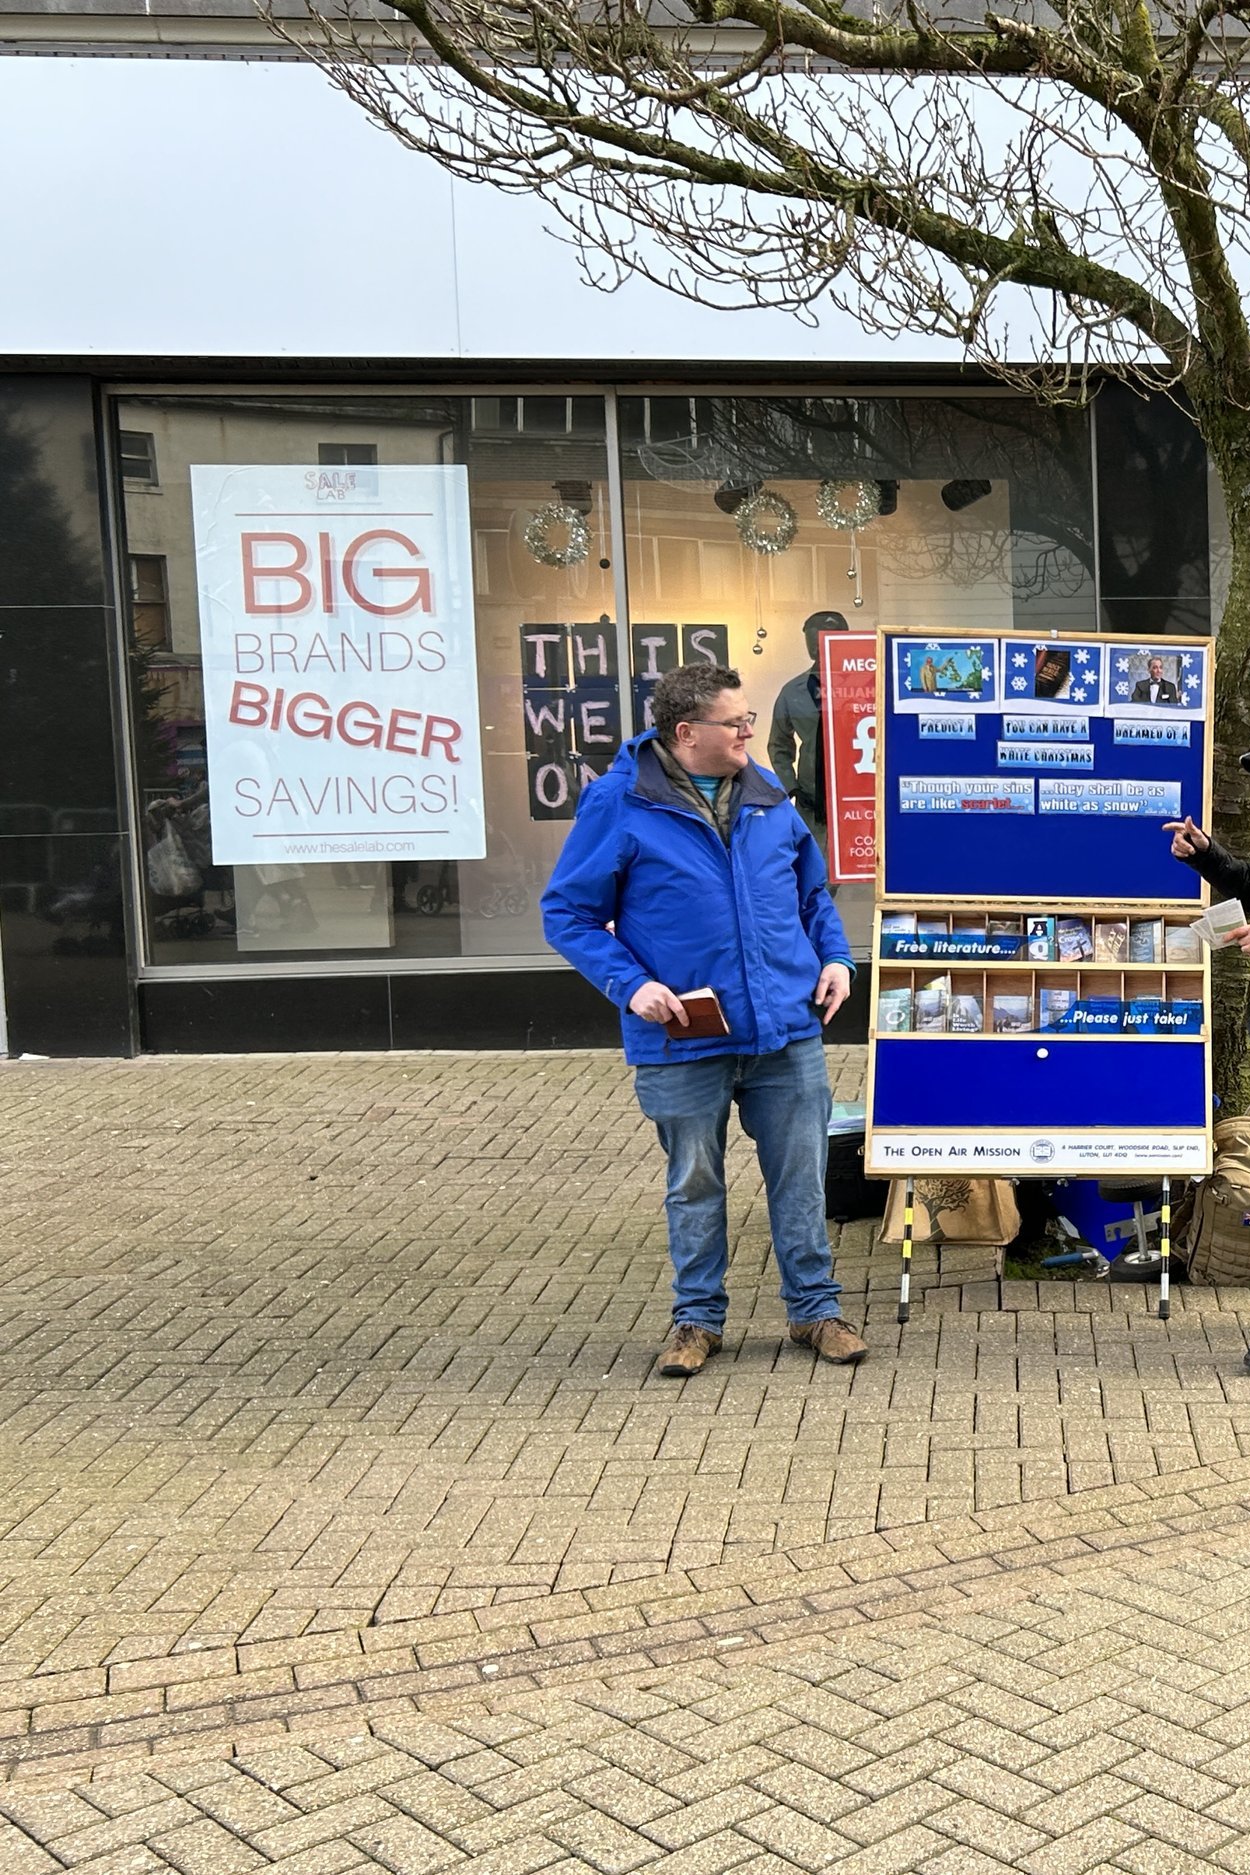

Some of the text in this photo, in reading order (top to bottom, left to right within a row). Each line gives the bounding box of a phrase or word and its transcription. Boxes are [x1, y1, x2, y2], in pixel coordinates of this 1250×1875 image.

[241, 529, 435, 617] BIG
[234, 631, 447, 675] BRANDS
[524, 629, 718, 681] THIS
[228, 680, 463, 764] BIGGER
[967, 719, 974, 733] A
[1029, 719, 1048, 734] CAN
[1051, 719, 1077, 734] HAVE
[1080, 719, 1087, 734] A
[1115, 724, 1188, 741] DREAMED OF A
[999, 746, 1093, 763] WHITE CHRISTMAS
[235, 774, 459, 817] SAVINGS!
[963, 783, 998, 796] your
[1003, 781, 1032, 794] sins
[1089, 783, 1122, 796] shall
[1127, 783, 1143, 797] be
[1148, 785, 1165, 797] as
[901, 798, 926, 810] are
[931, 797, 956, 810] like
[1040, 798, 1078, 811] white
[1083, 800, 1099, 812] as
[844, 810, 863, 820] ALL
[284, 840, 415, 855] www.thesalelab.com
[895, 939, 928, 953] Free
[1122, 1012, 1149, 1027] just
[1154, 1012, 1188, 1025] take!
